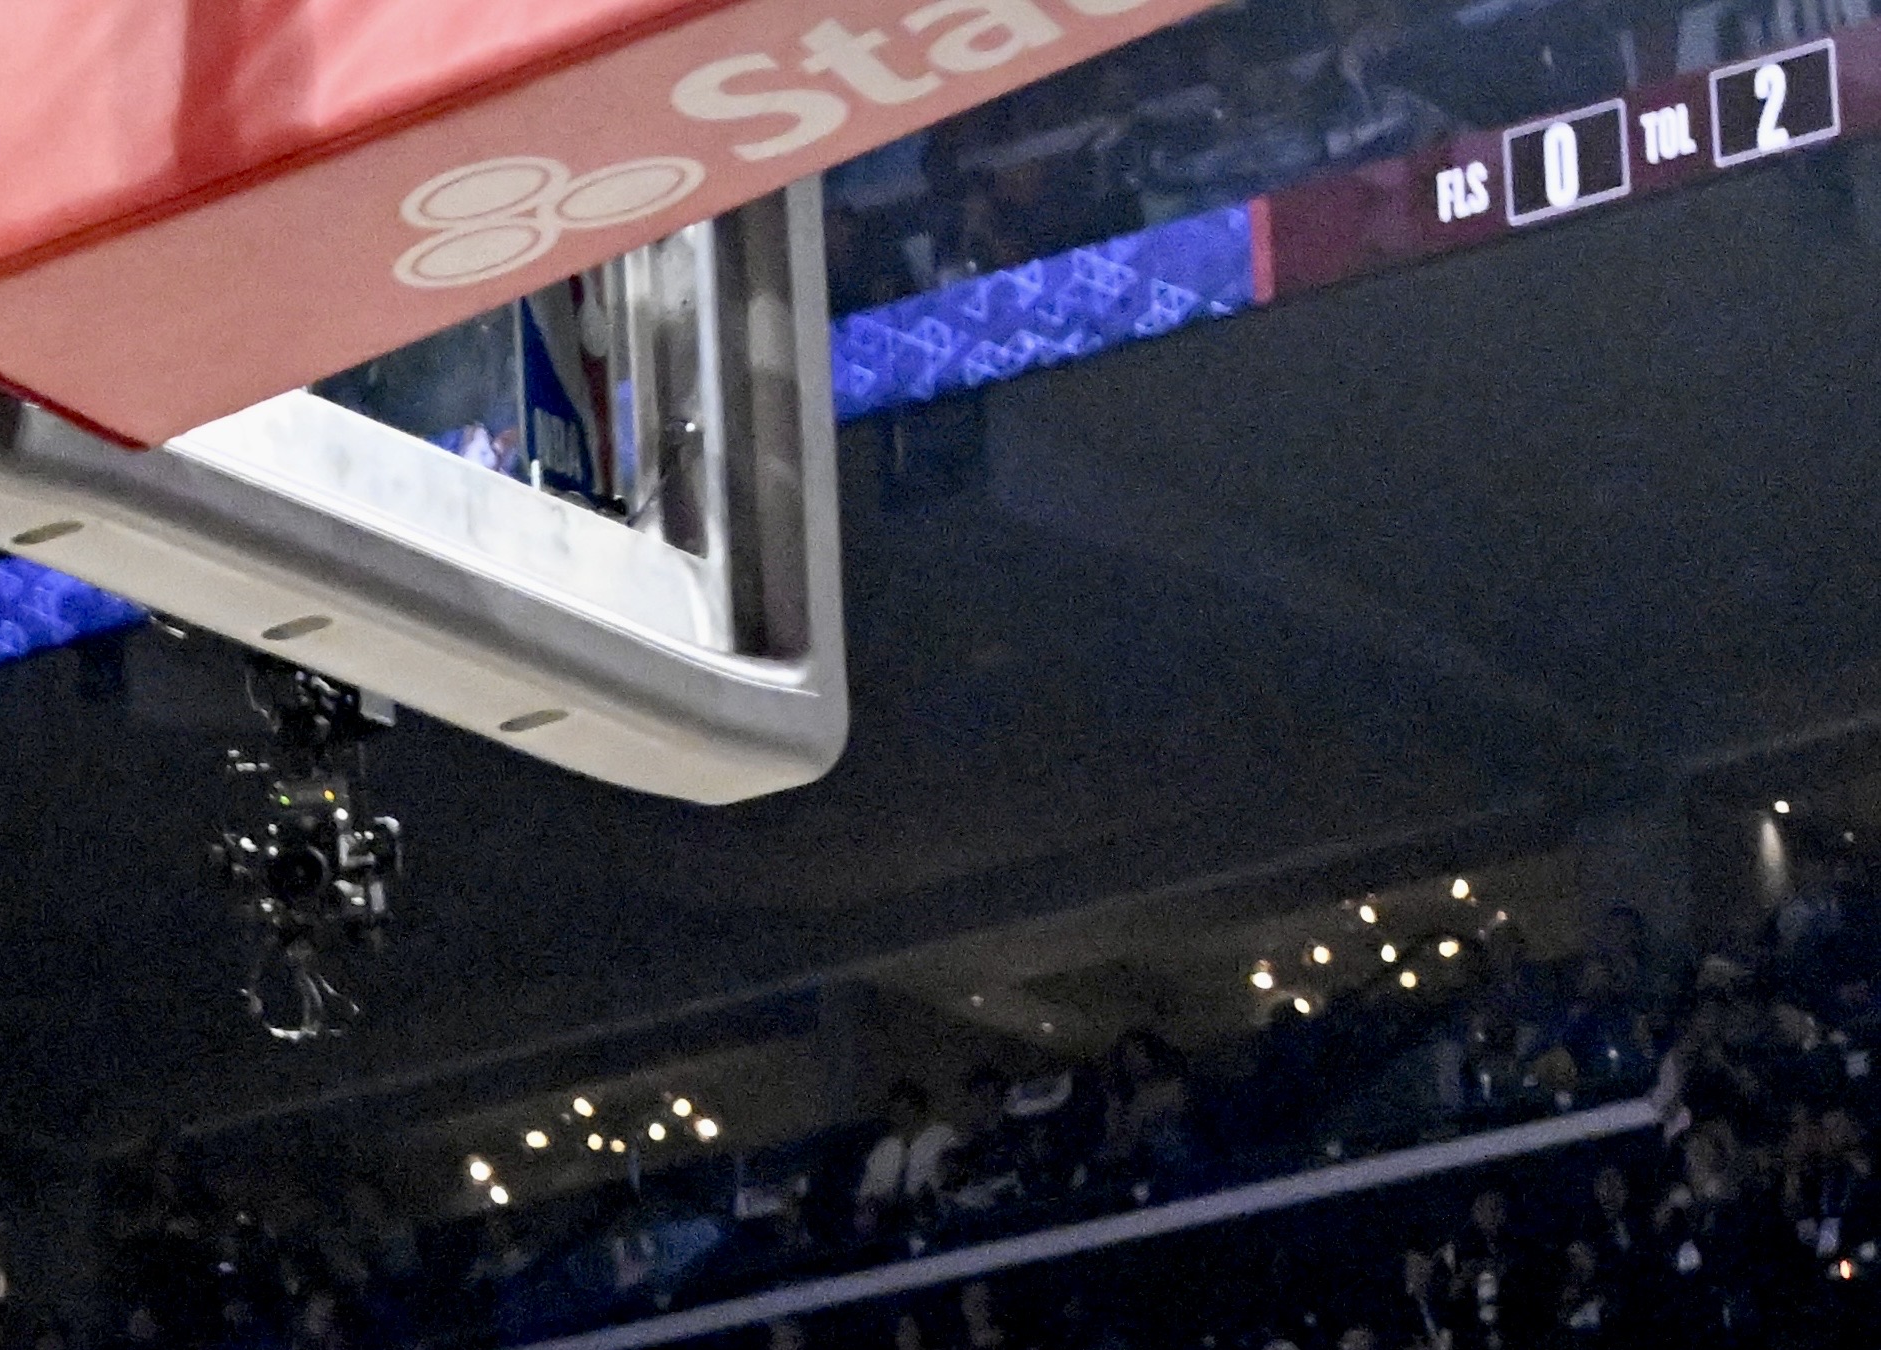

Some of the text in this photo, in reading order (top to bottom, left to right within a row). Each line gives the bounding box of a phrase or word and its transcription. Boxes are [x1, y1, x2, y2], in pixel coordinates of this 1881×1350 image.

[1435, 62, 1791, 224] FLS 0 TOL 2
